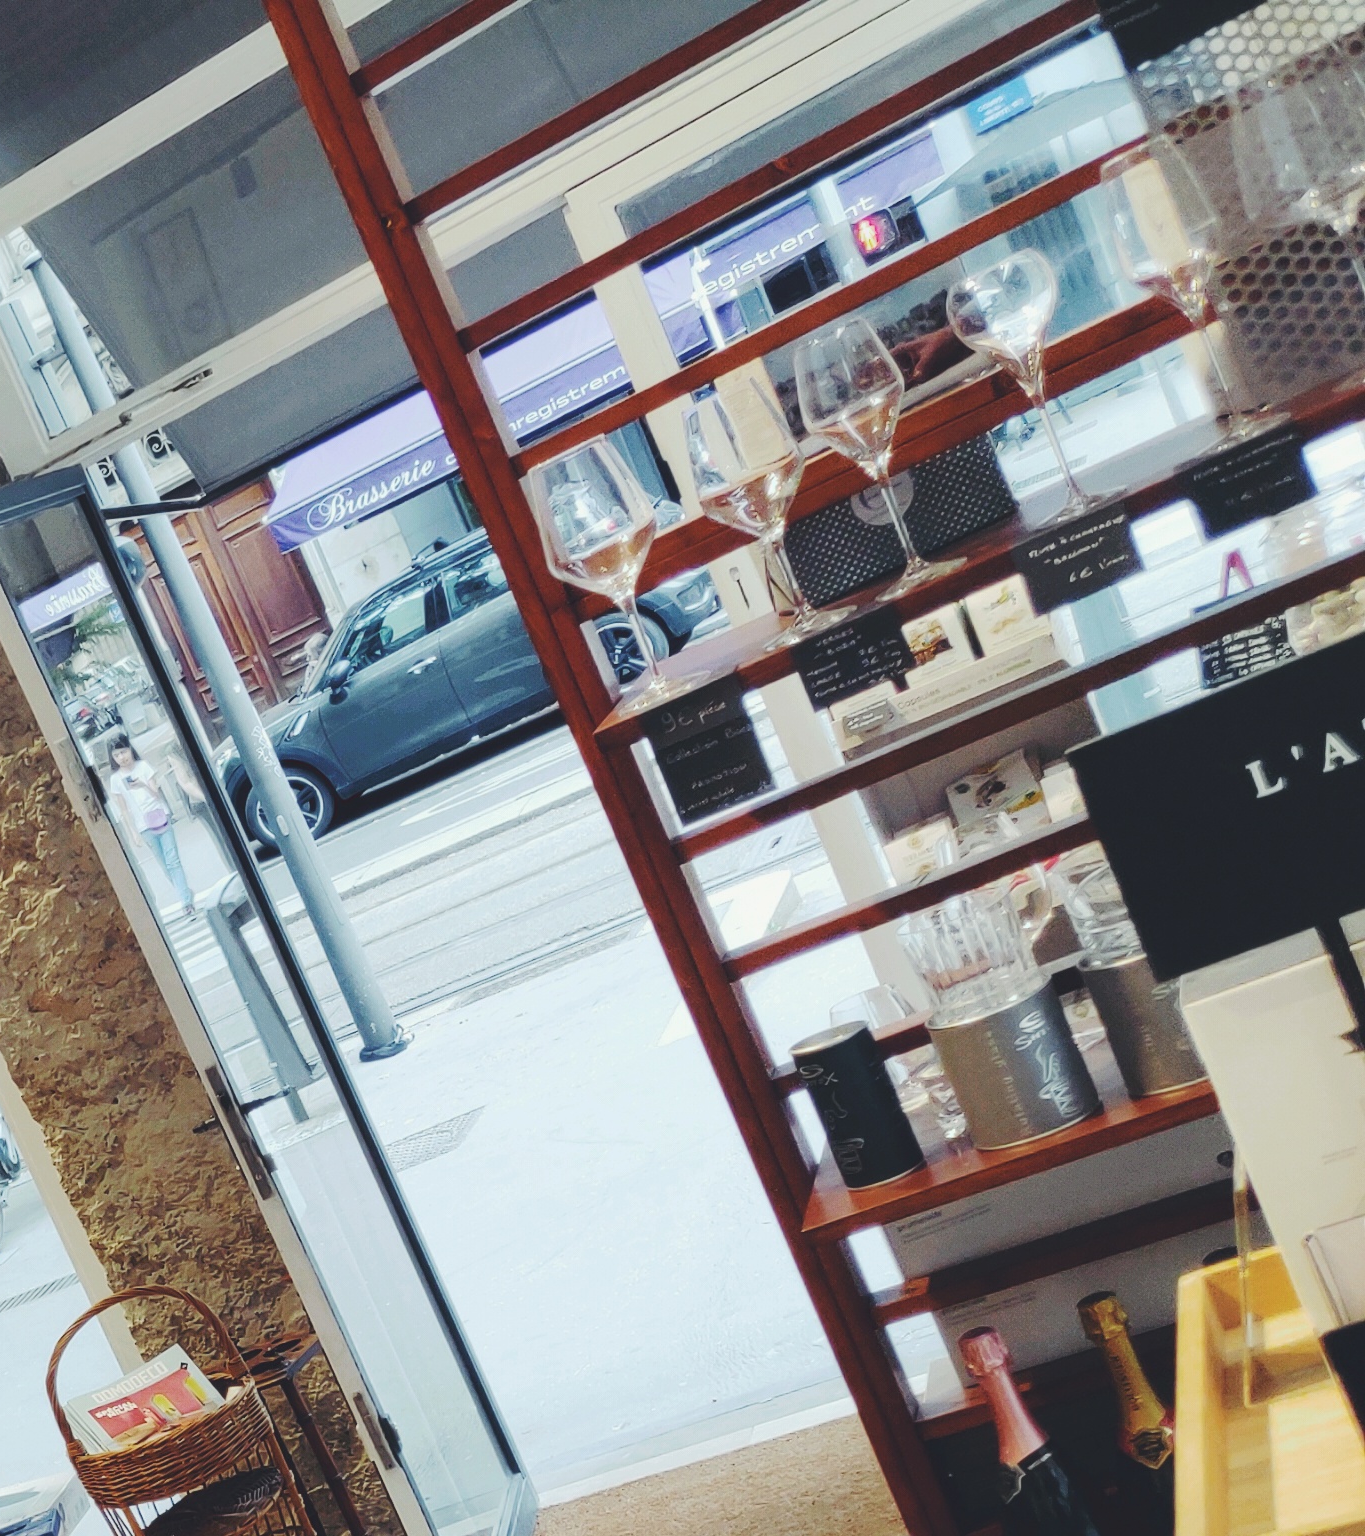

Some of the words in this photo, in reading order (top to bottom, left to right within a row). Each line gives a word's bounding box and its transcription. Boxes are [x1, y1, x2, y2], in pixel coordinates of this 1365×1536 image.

[508, 363, 627, 432] nregistrem
[306, 458, 437, 531] Brasserie
[1245, 724, 1365, 797] L'A
[91, 1359, 167, 1404] DOMODECO
